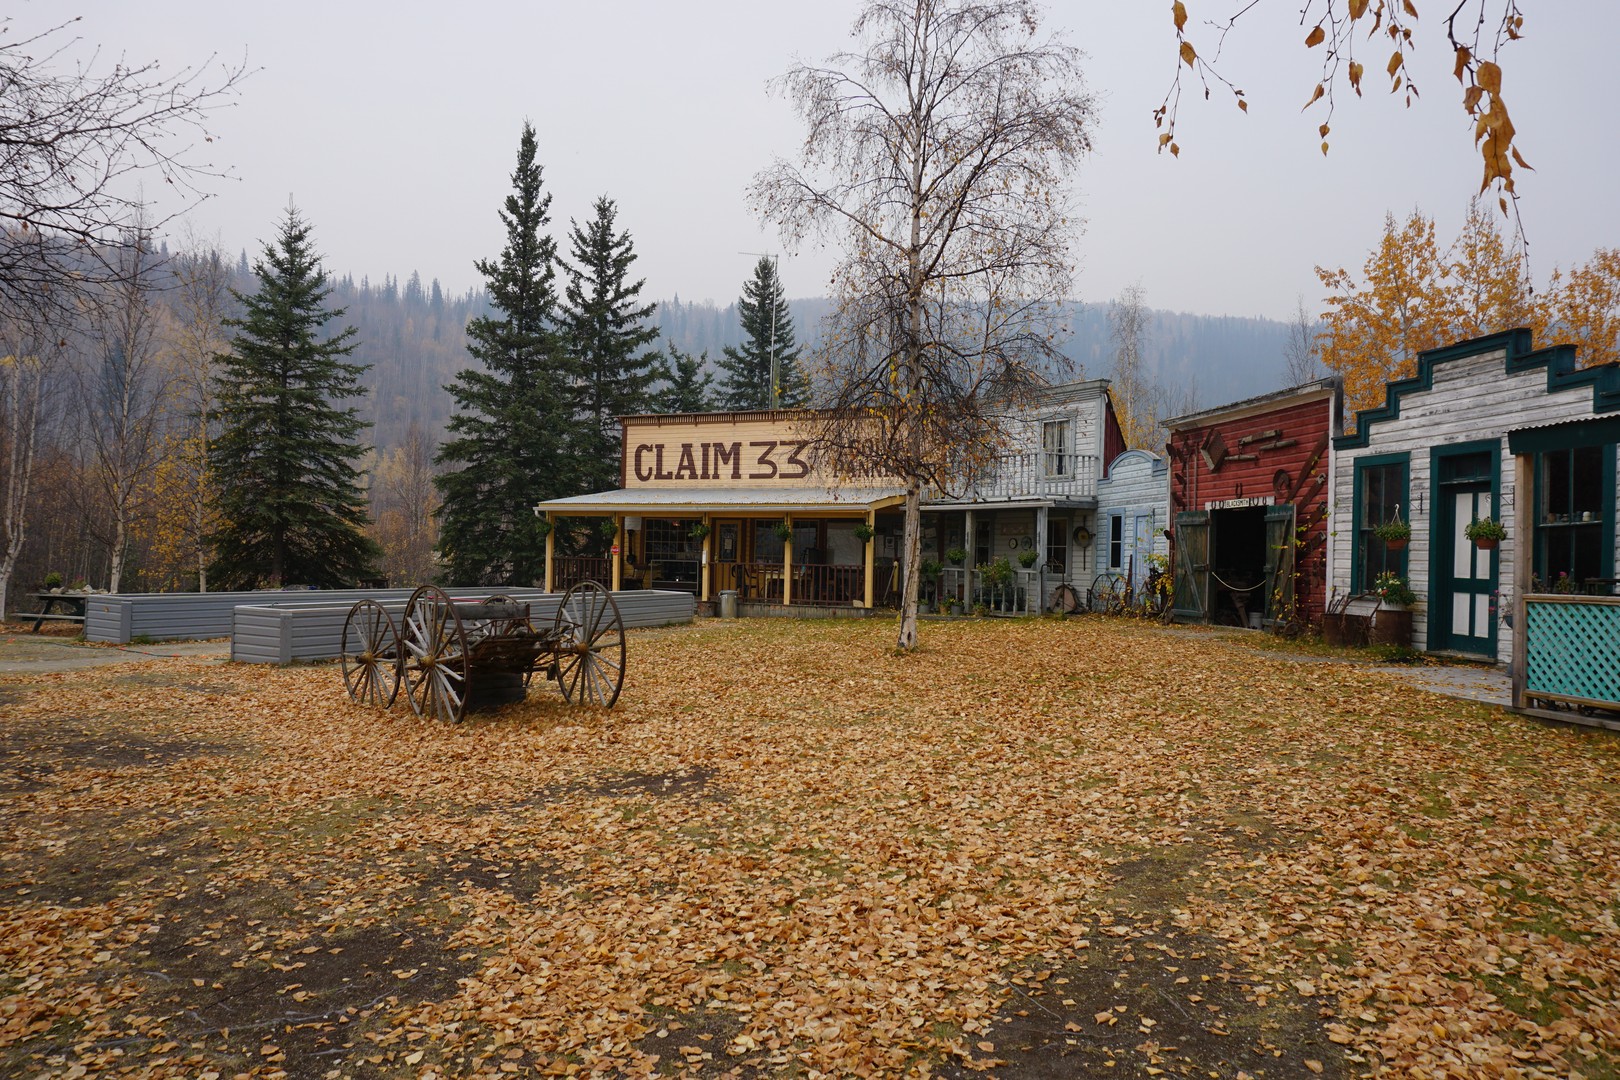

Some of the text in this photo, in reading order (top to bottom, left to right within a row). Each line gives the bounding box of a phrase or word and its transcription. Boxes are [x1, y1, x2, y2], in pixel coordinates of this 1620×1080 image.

[634, 442, 742, 482] CLAIM
[749, 440, 809, 479] 33
[1226, 499, 1249, 508] BLACKSMITH
